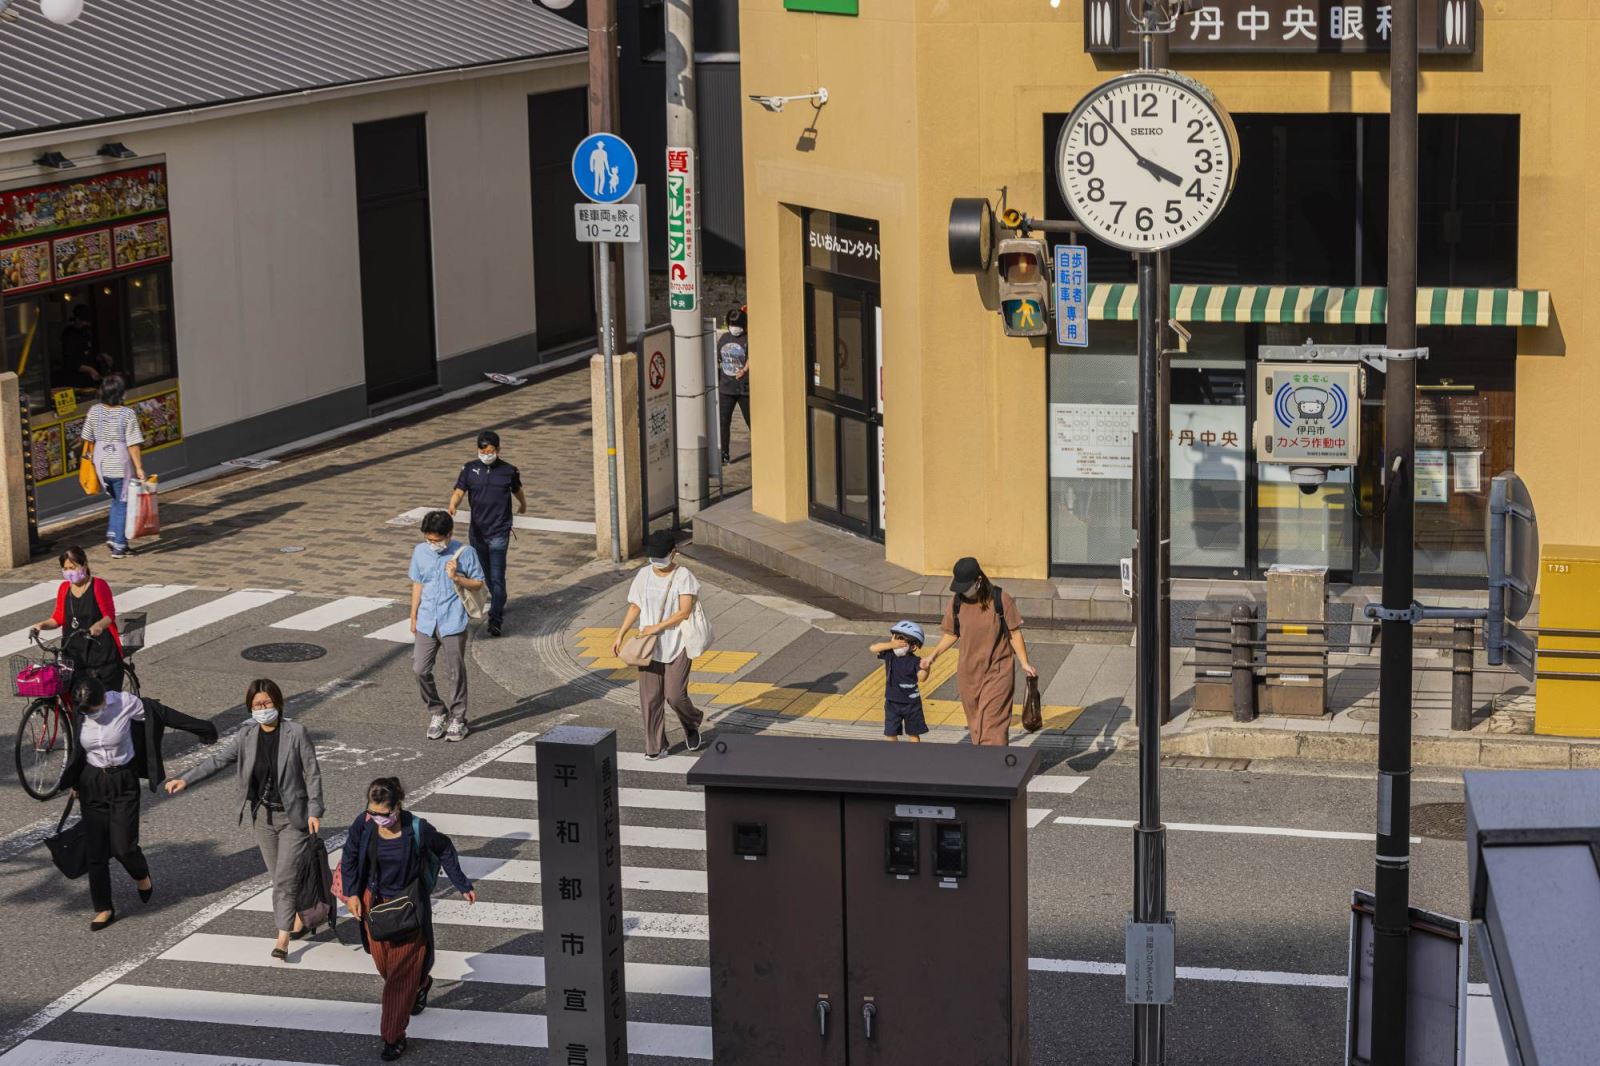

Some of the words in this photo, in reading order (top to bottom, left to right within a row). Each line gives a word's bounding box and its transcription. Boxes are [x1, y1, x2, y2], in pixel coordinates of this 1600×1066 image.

[1190, 5, 1392, 40] 丹中央眼
[1109, 99, 1127, 124] 11
[1133, 92, 1159, 118] 12
[1172, 99, 1177, 124] 1
[1084, 121, 1108, 147] 10
[1130, 127, 1164, 136] SEIKO
[1186, 118, 1205, 144] 2
[668, 150, 689, 173] 質
[1076, 151, 1095, 176] 9
[1194, 149, 1213, 174] 3
[1087, 177, 1105, 203] 8
[1185, 178, 1205, 202] 4
[579, 209, 634, 222] 軽車両を除く
[669, 176, 684, 260] マルニシ
[1109, 201, 1127, 225] 7
[1135, 206, 1154, 232] 6
[1164, 200, 1183, 224] 5
[809, 230, 881, 261] らいおんコンタクト
[1060, 253, 1070, 302] 自転車
[1072, 253, 1082, 303] 歩行者
[1067, 305, 1077, 339] 専用
[1168, 430, 1238, 447] 丹中央
[1276, 437, 1346, 449] カメラ作動中
[1296, 425, 1326, 436] 伊丹市
[553, 764, 590, 1066] 平和都市宣言
